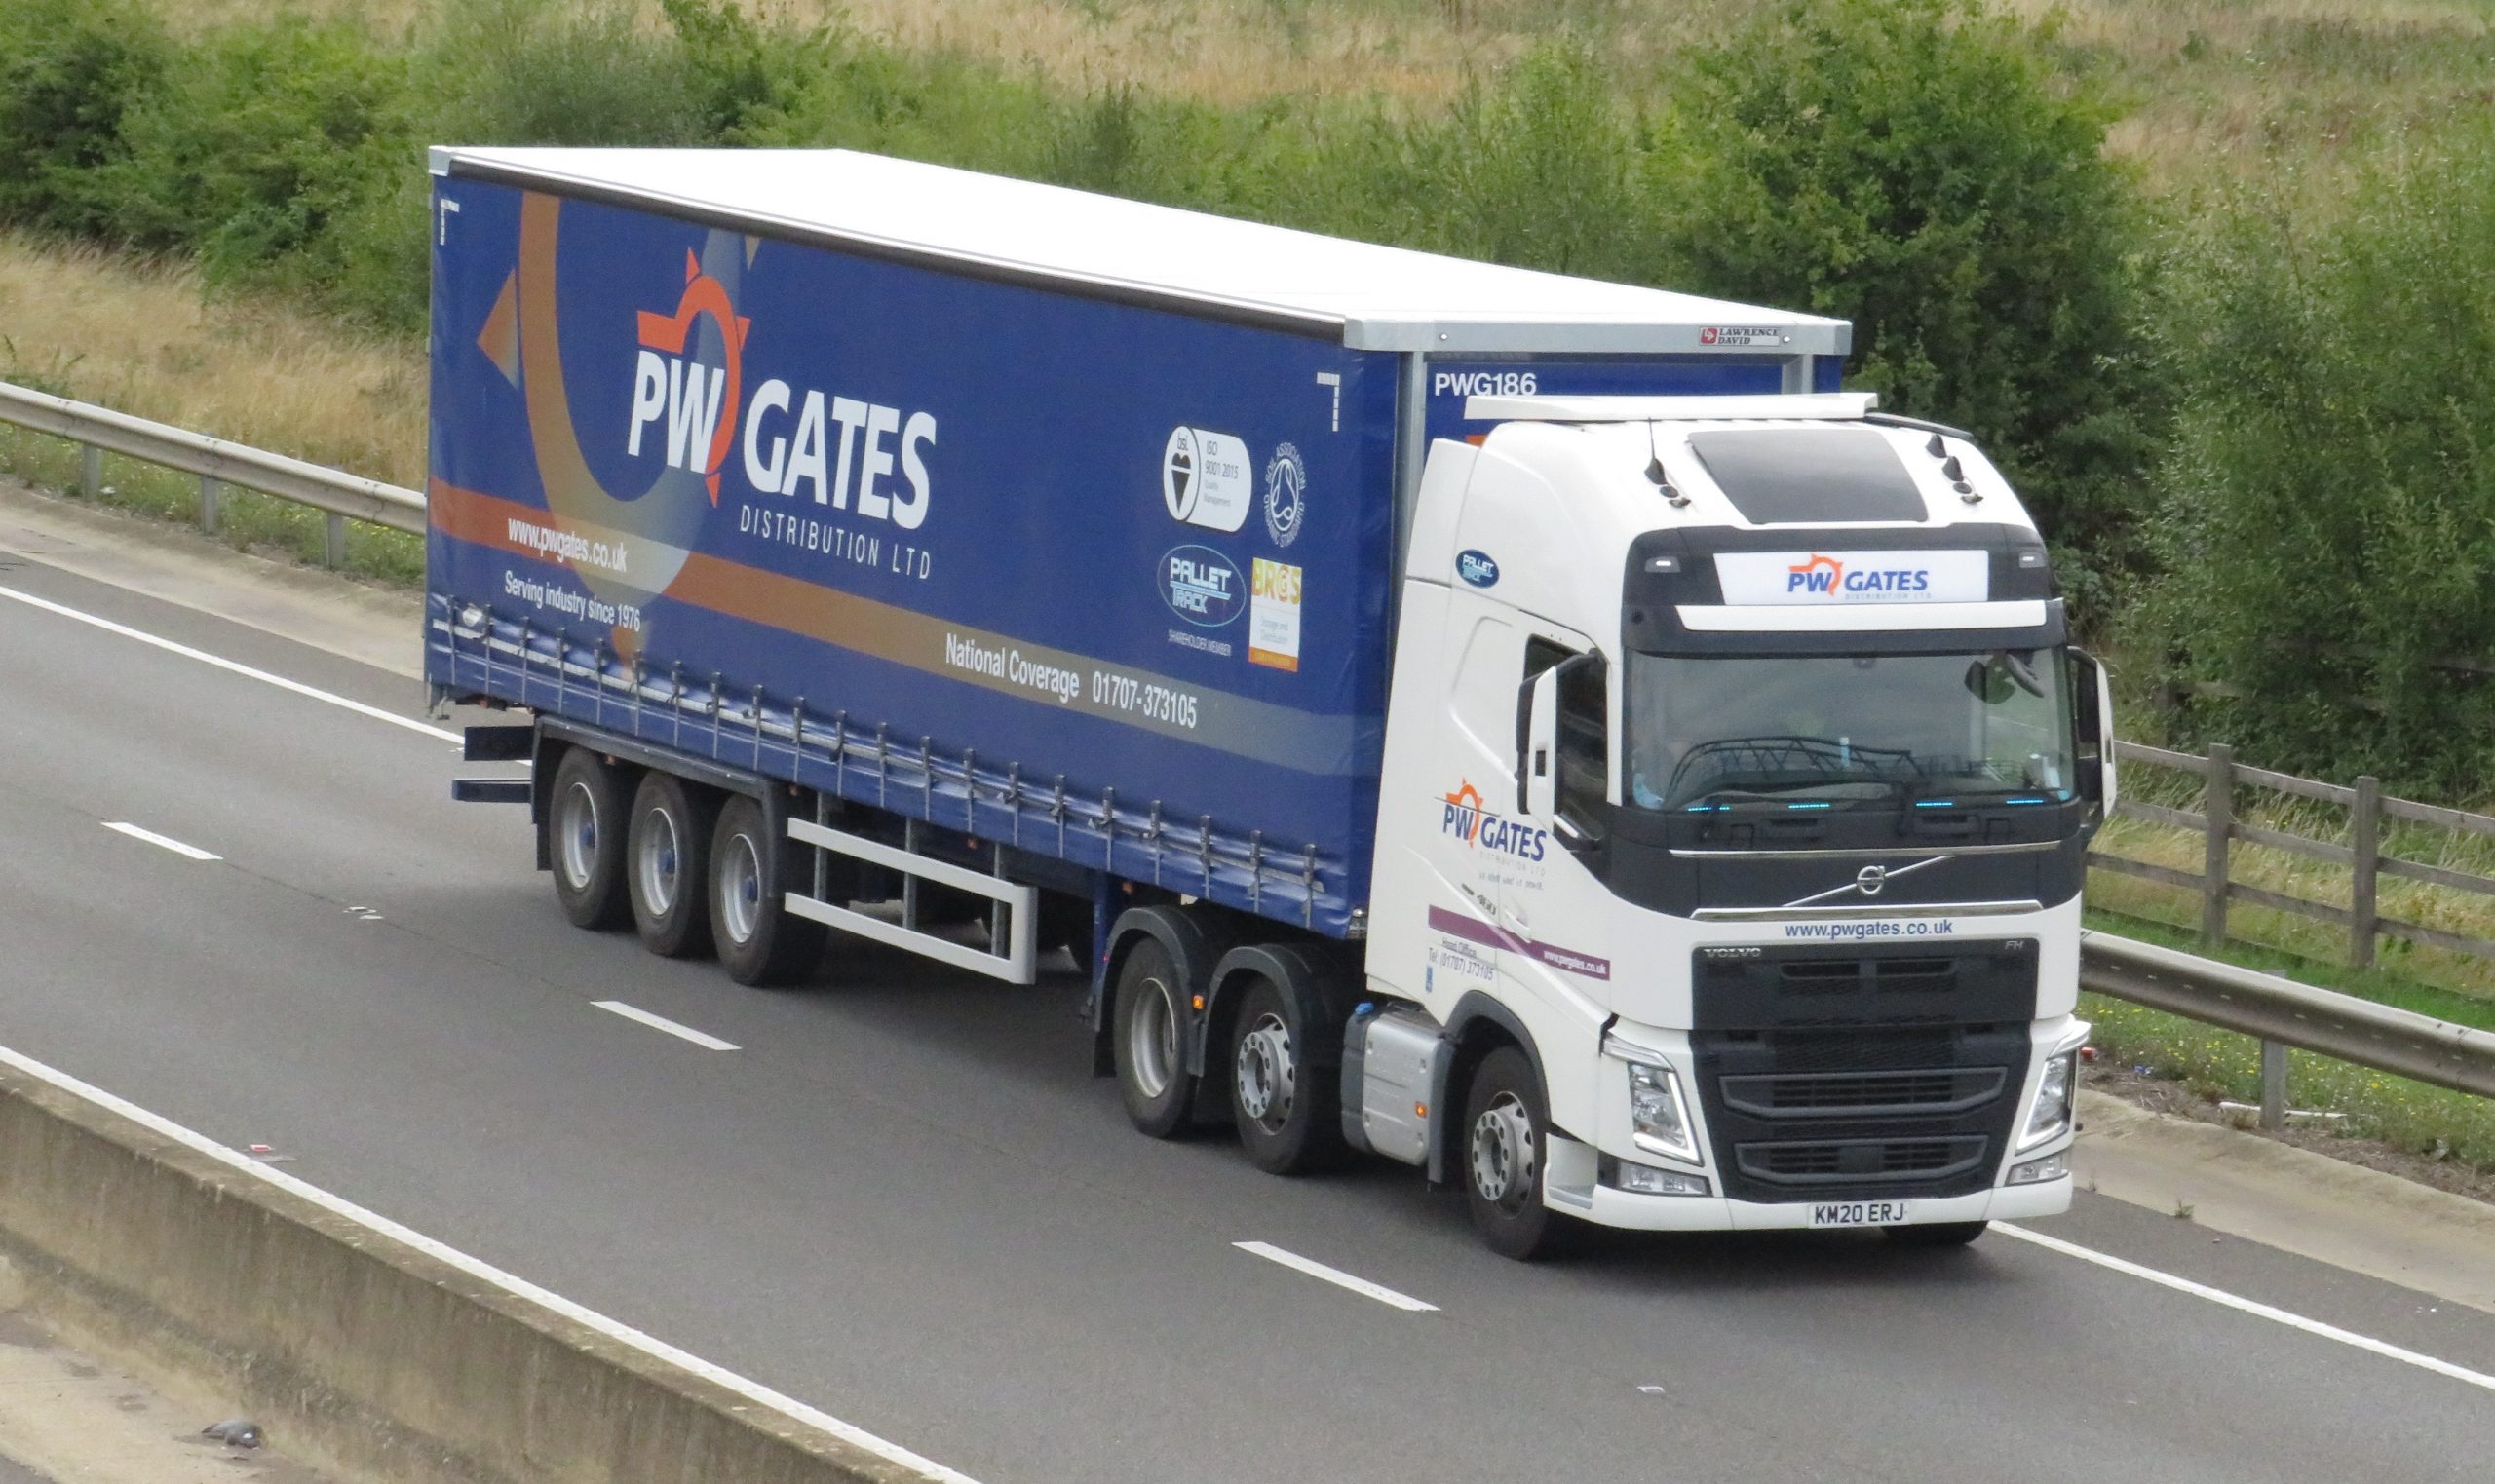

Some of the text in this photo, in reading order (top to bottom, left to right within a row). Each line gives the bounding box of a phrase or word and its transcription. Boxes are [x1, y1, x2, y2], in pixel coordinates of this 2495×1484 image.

[1718, 336, 1750, 345] DAVID
[1435, 372, 1537, 396] PWG186
[628, 350, 937, 530] PW GATES
[1206, 440, 1218, 456] ISO
[1221, 463, 1239, 480] 2015
[508, 517, 628, 572] www.pwgates.co.uk
[740, 504, 932, 580] DISTRIBUTION LTD
[1170, 556, 1232, 592] PALLET
[1787, 570, 1929, 592] PW GATES
[505, 569, 641, 632] Serving industry since 1976
[1172, 586, 1209, 614] TRACK
[945, 632, 1198, 729] National Coverage 01707-373105
[1442, 803, 1547, 862] PW GATES
[1785, 919, 1953, 940] www.pwgates.co.uk
[1703, 947, 1762, 959] VOLVO
[2004, 939, 2024, 951] FH
[1815, 1202, 1905, 1225] KM20 ERJ
